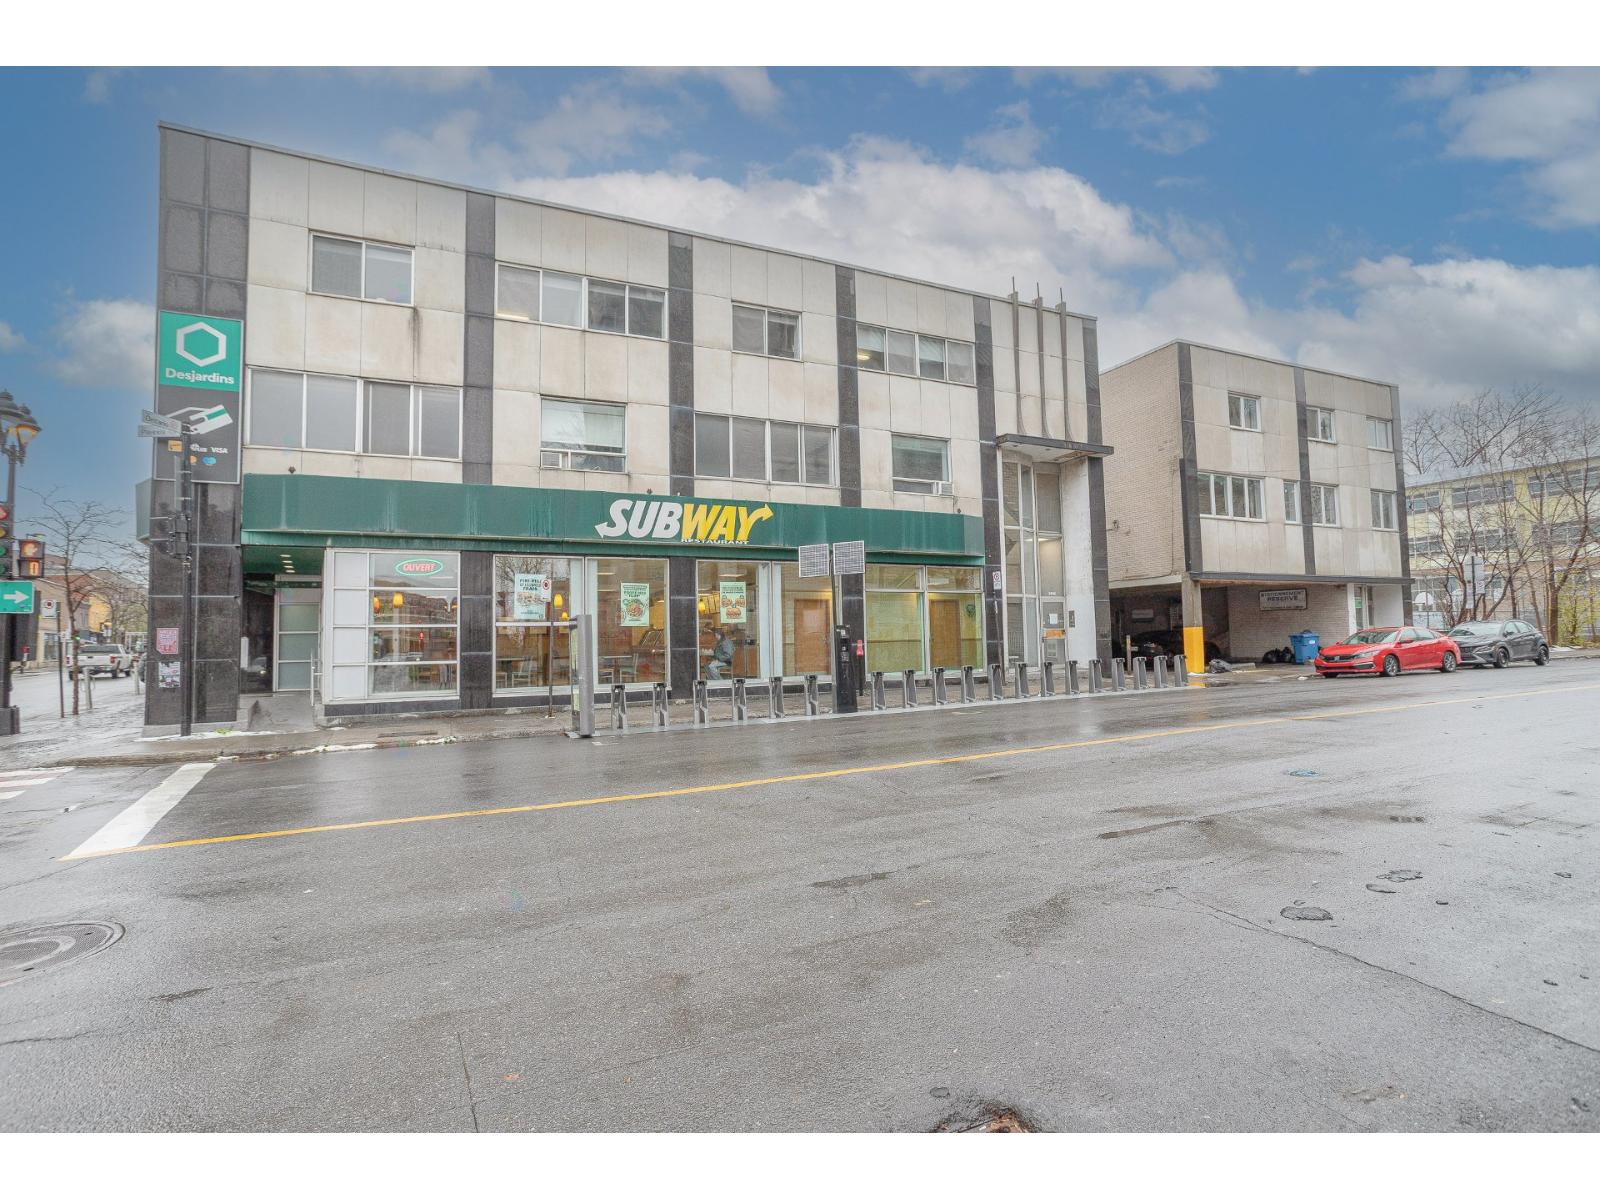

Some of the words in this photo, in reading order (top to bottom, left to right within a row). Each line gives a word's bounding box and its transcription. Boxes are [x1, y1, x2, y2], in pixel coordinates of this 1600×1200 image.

[165, 368, 234, 384] Desjardins
[594, 498, 774, 540] SUBWAY
[403, 562, 437, 572] OUVERT
